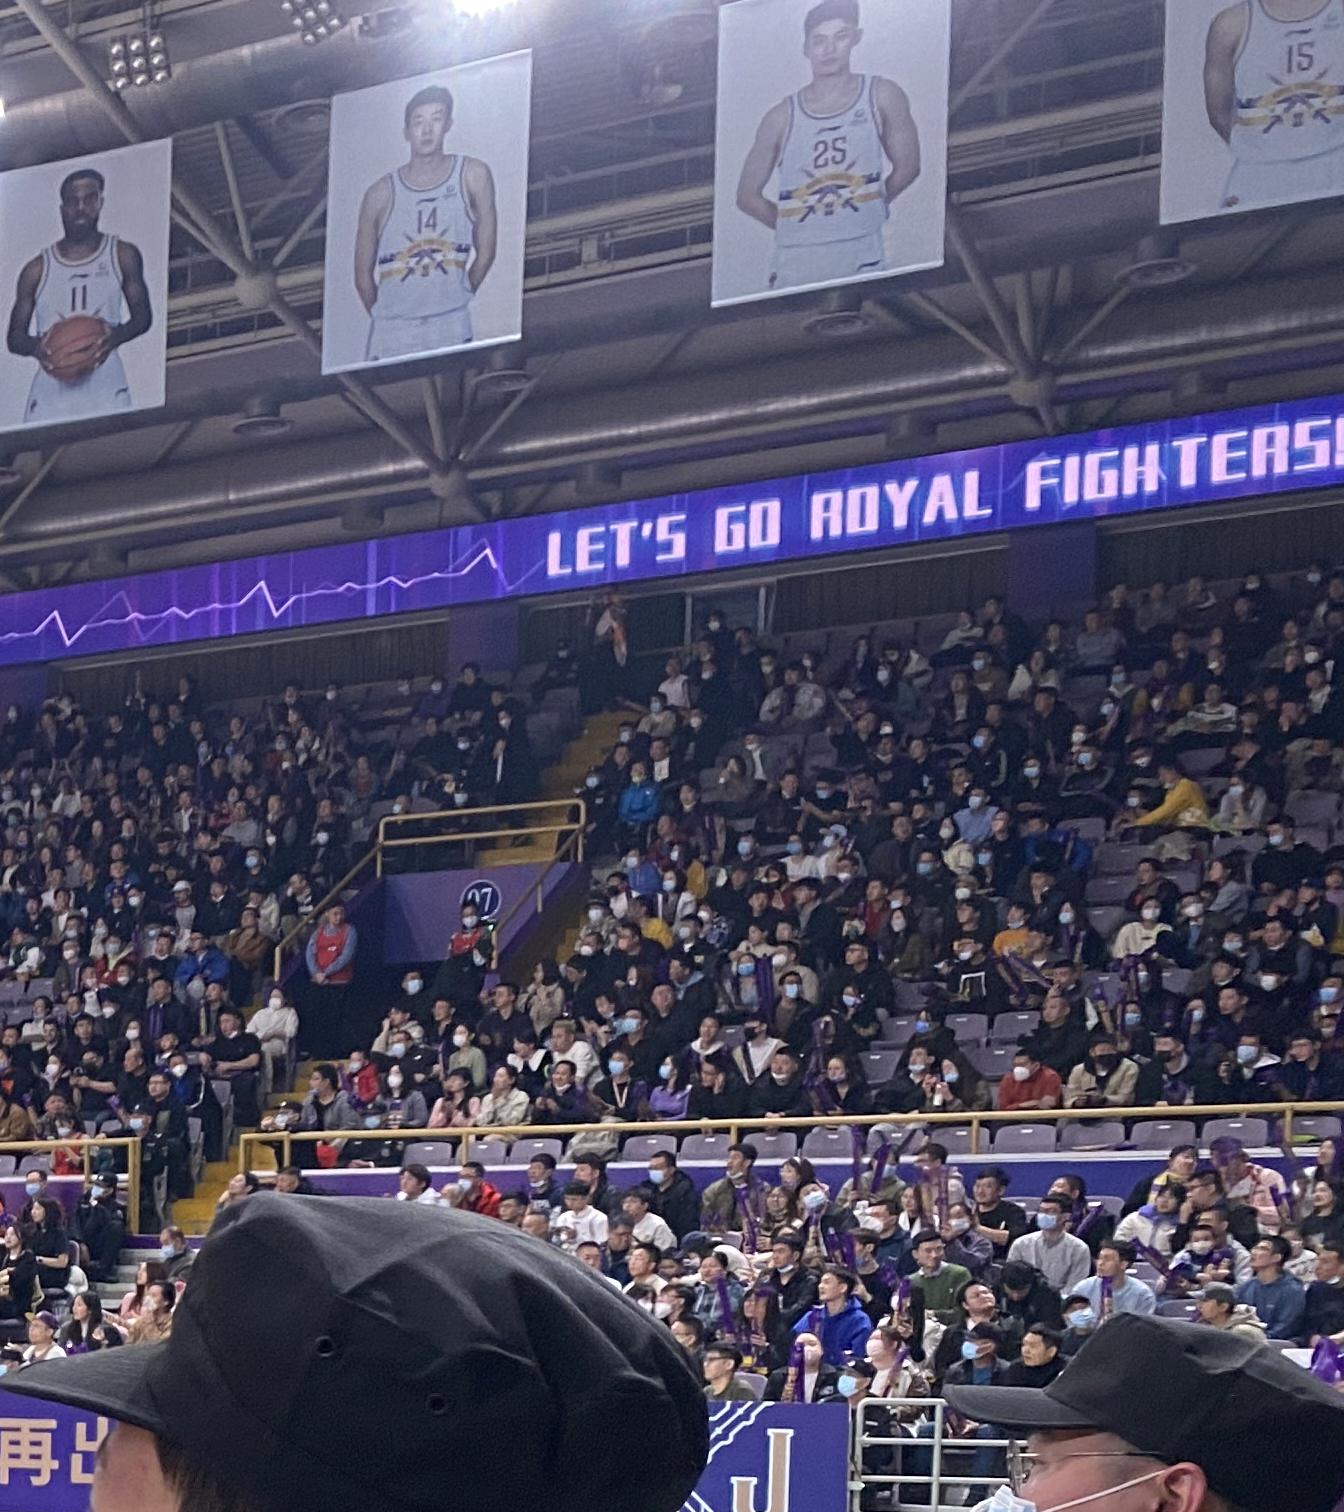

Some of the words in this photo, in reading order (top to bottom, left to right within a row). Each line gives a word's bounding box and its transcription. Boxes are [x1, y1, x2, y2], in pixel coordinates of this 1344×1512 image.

[1287, 41, 1315, 74] 15
[814, 136, 847, 169] 25
[417, 206, 437, 234] 14
[71, 284, 87, 312] 11
[546, 514, 686, 578] LET'S
[714, 498, 781, 554] GO
[810, 471, 993, 541] ROYAL
